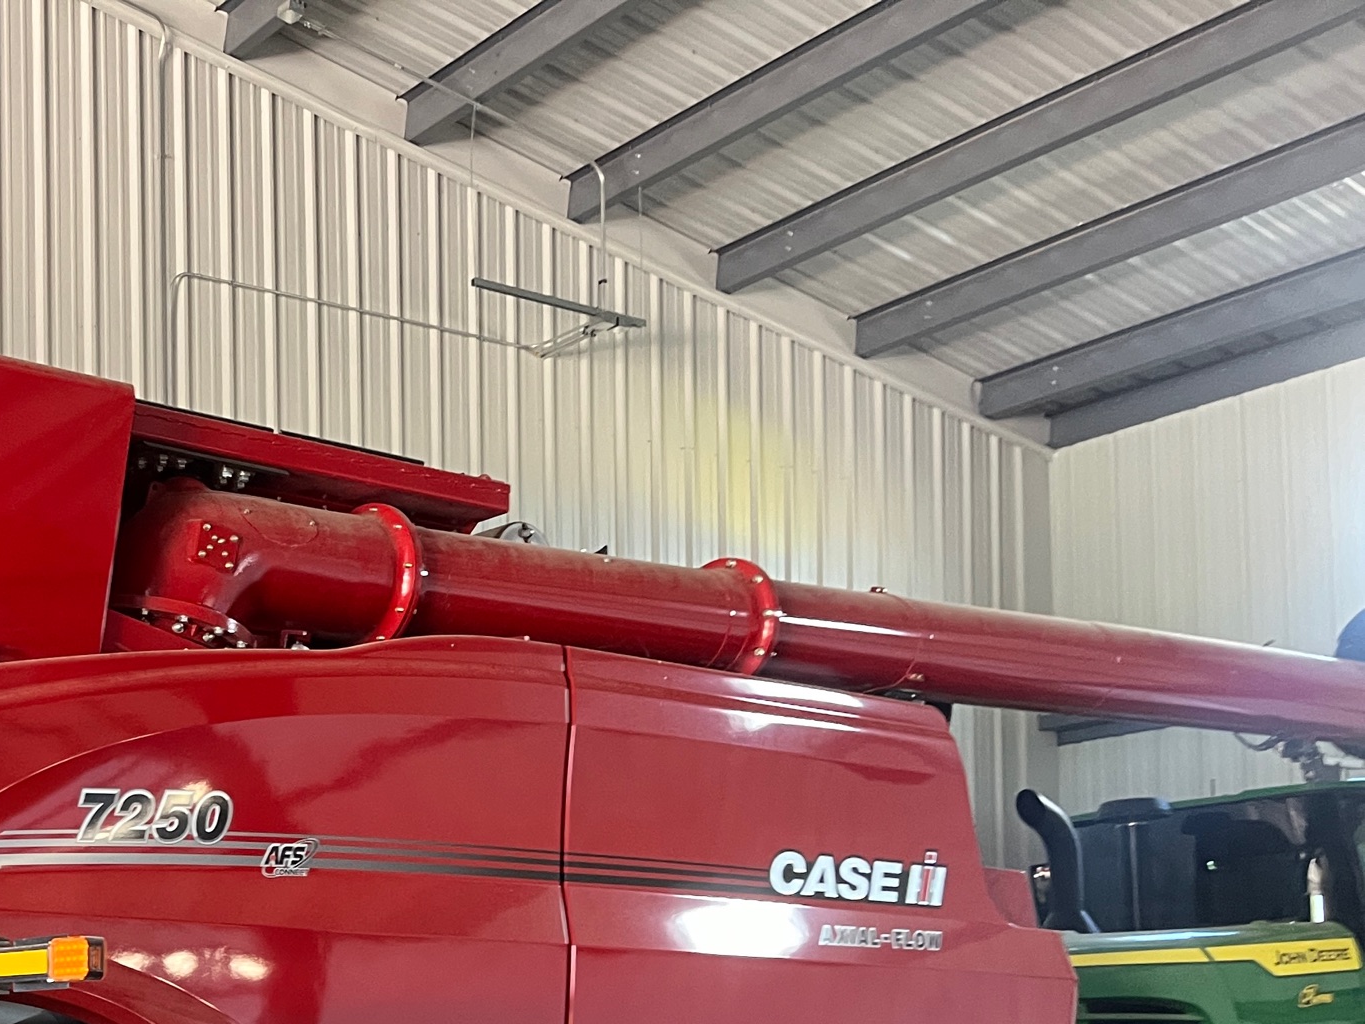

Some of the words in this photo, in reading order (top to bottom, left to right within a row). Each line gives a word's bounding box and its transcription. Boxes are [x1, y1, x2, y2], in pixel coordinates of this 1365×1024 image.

[75, 787, 235, 845] 7250
[261, 843, 309, 867] AFS
[769, 850, 904, 902] CASE
[818, 924, 943, 951] AXIAL-FLOW
